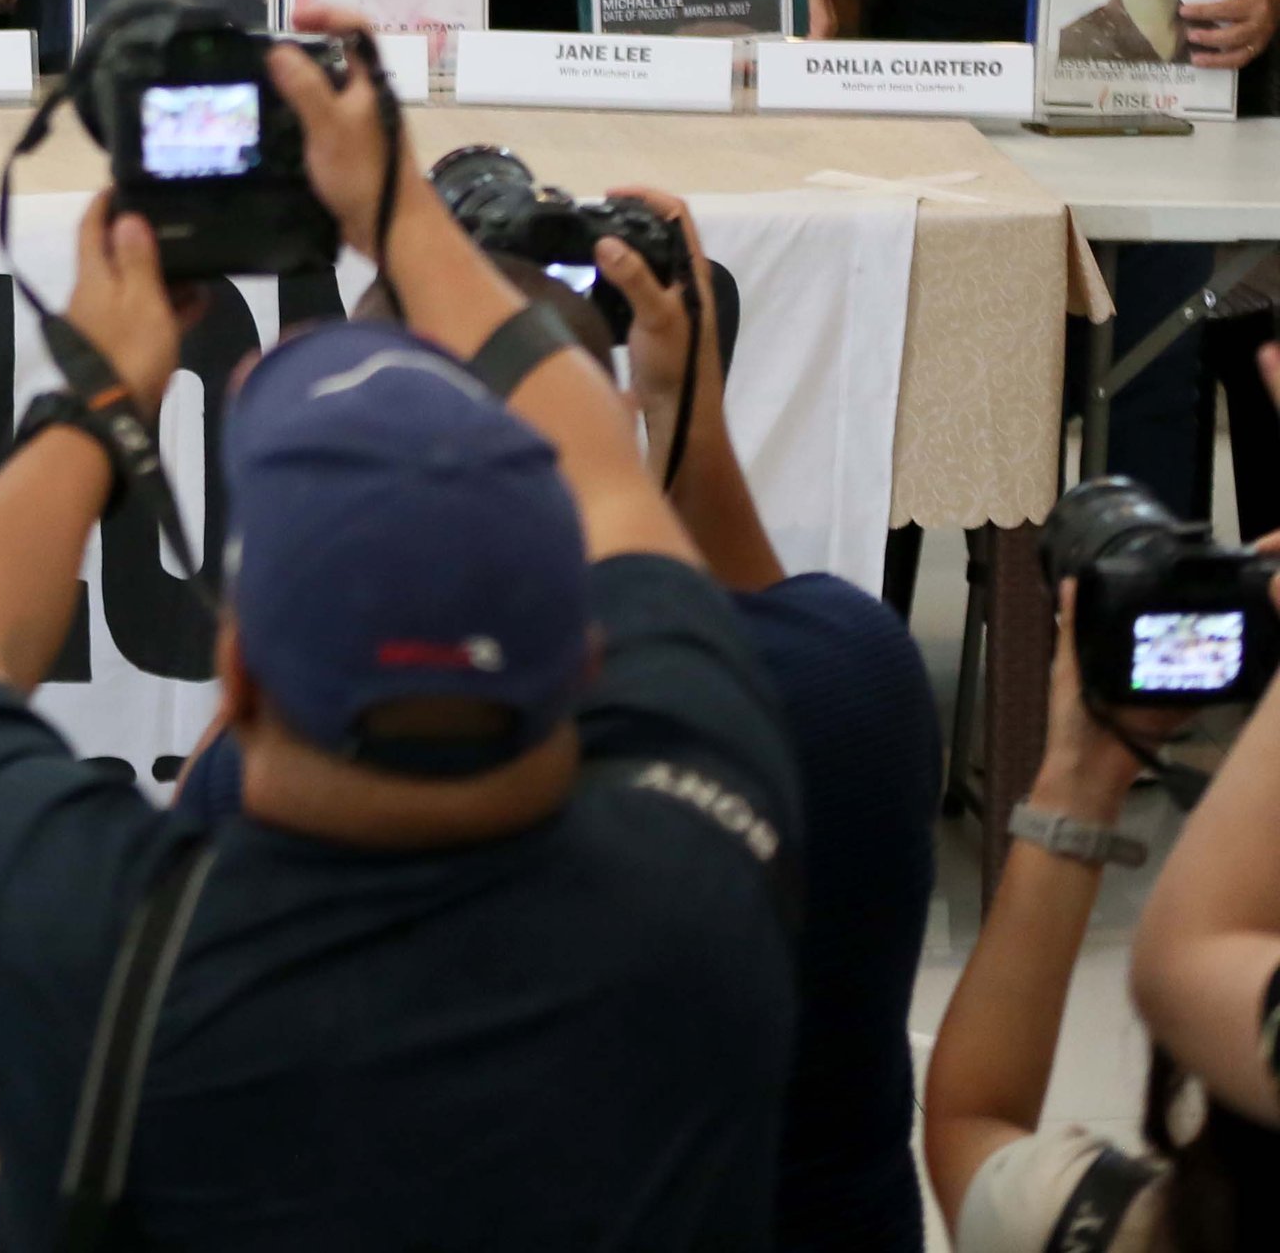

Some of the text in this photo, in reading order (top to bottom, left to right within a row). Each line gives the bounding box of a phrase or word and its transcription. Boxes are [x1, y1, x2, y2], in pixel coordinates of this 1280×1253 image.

[603, 5, 713, 22] DATE OF MARCH
[555, 44, 652, 63] JANE LEE
[560, 67, 649, 79] Wife of Michael Lee
[806, 59, 1003, 77] DAHLIA CUARTERO
[842, 82, 874, 92] Mother
[1112, 92, 1179, 108] RISE UP
